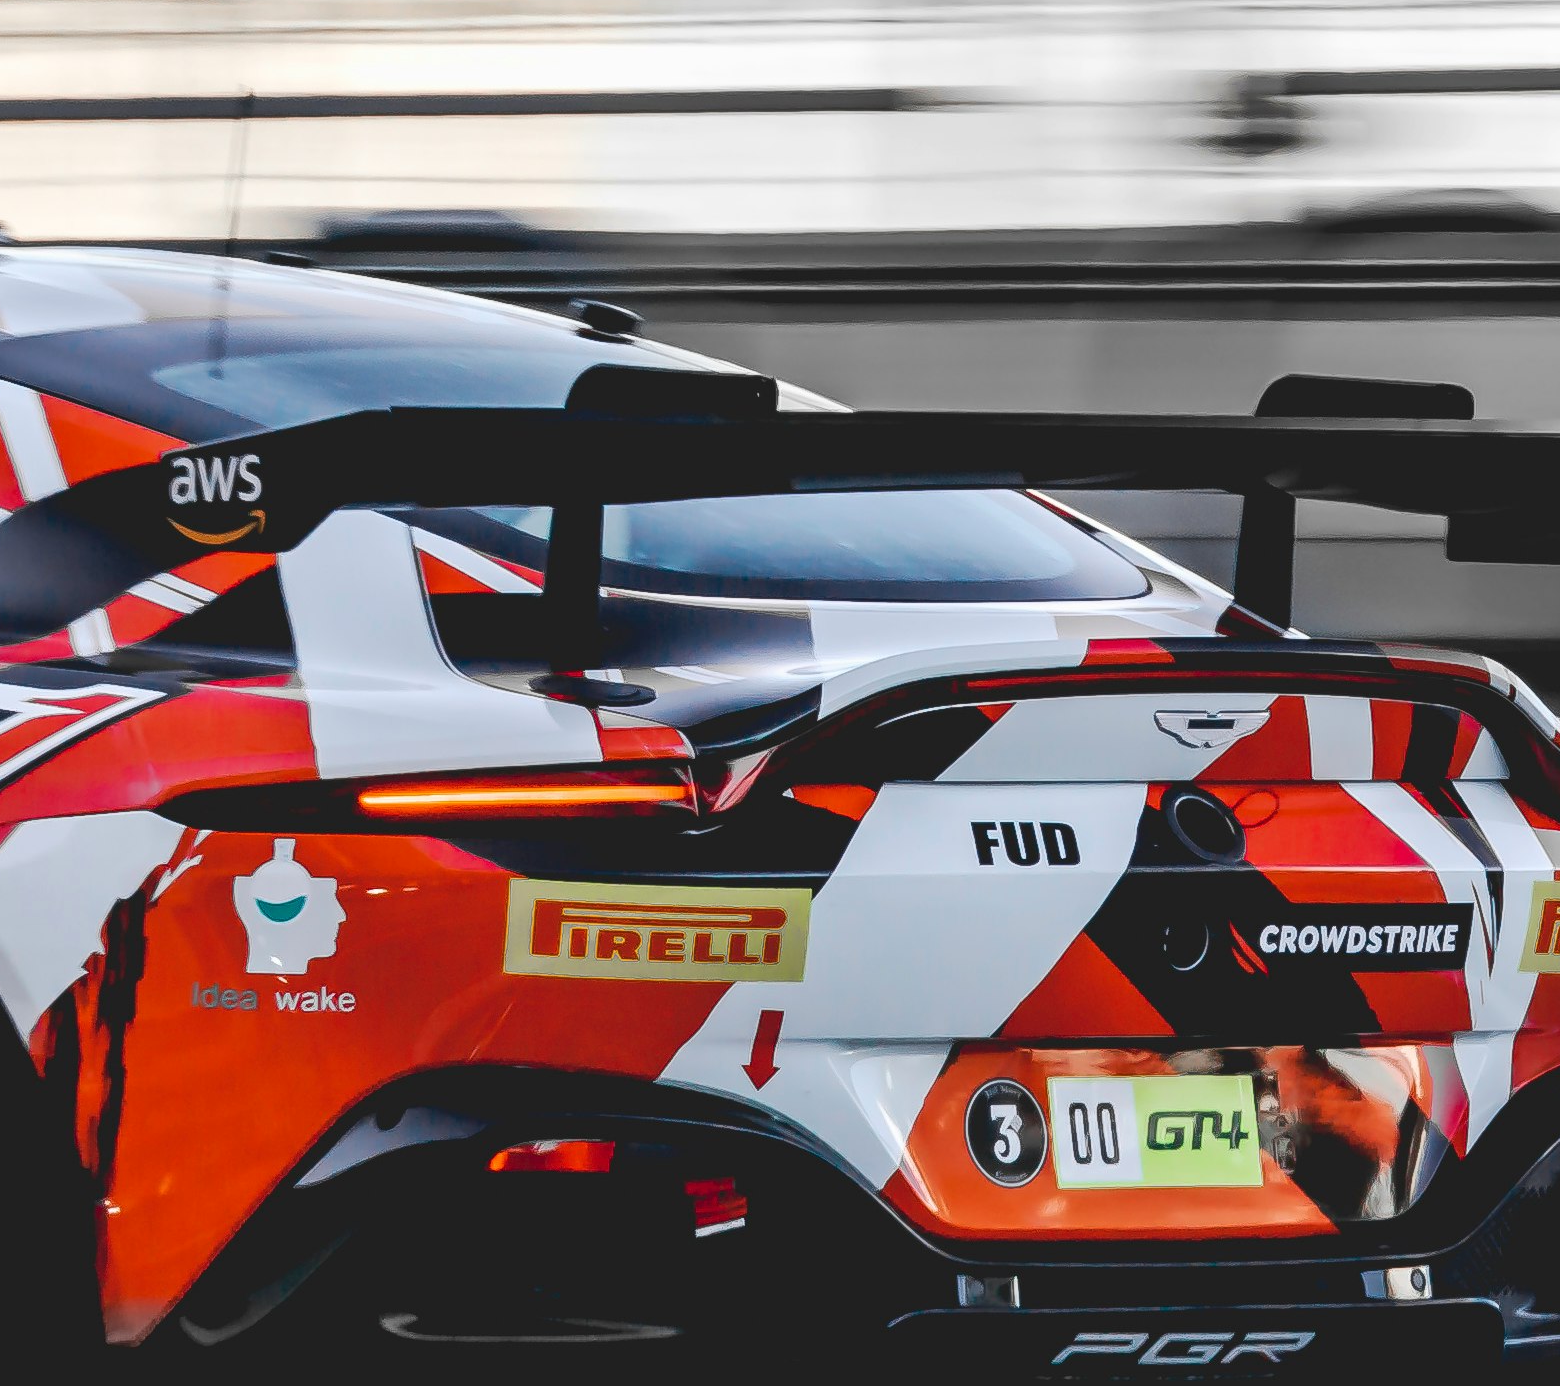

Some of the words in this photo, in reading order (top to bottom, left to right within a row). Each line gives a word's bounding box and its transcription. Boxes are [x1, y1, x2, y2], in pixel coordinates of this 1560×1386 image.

[169, 454, 262, 504] aws
[970, 821, 1081, 867] FUD
[530, 898, 787, 965] PIRELLI
[1259, 924, 1459, 954] CROWDSTRIKE
[191, 981, 258, 1010] Idea
[275, 986, 356, 1013] wake
[990, 1104, 1023, 1164] 3
[1068, 1102, 1120, 1165] 00
[1146, 1111, 1249, 1151] GT4
[1051, 1332, 1316, 1364] PGR
